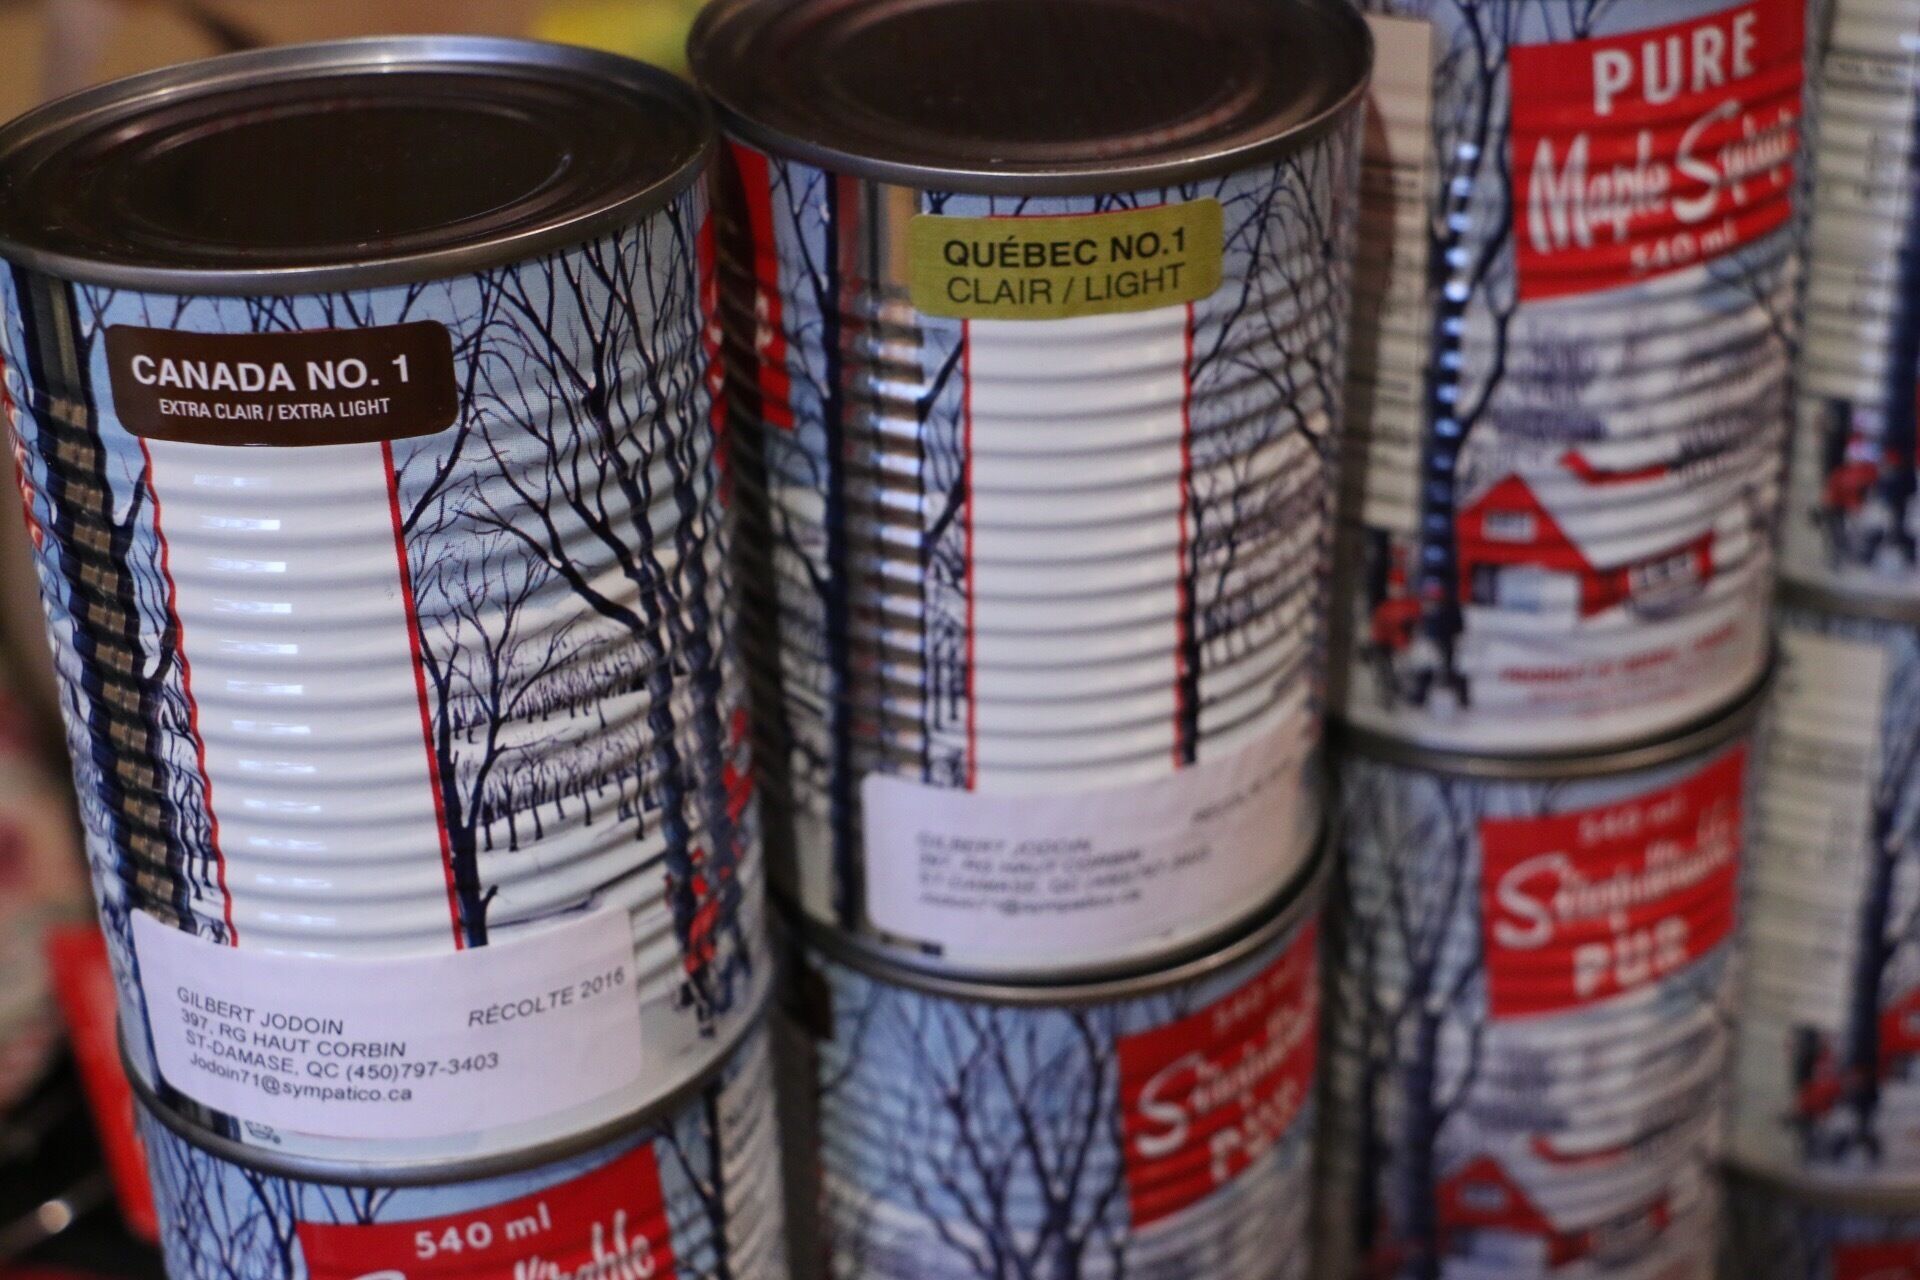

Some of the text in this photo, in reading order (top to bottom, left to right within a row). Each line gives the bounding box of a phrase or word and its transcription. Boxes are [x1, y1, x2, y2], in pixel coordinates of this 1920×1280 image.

[1592, 10, 1757, 116] PURE
[943, 226, 1186, 269] QUÉBEC NO.1
[946, 276, 1053, 304] CLAIR
[1085, 261, 1186, 301] LIGHT
[131, 354, 410, 392] CANADA NO. 1
[159, 398, 211, 419] EXTRA
[215, 403, 264, 421] CLAIR
[278, 403, 336, 421] EXTRA
[340, 397, 391, 418] LIGHT
[177, 986, 343, 1036] GILBERT JODOIN
[468, 966, 624, 1027] RÉCOLTE 2016
[220, 1023, 247, 1043] RG
[253, 1032, 310, 1053] HAUT
[317, 1041, 406, 1058] CORBIN
[306, 1060, 339, 1079] QC
[414, 1221, 493, 1259] 540
[505, 1201, 552, 1241] ml
